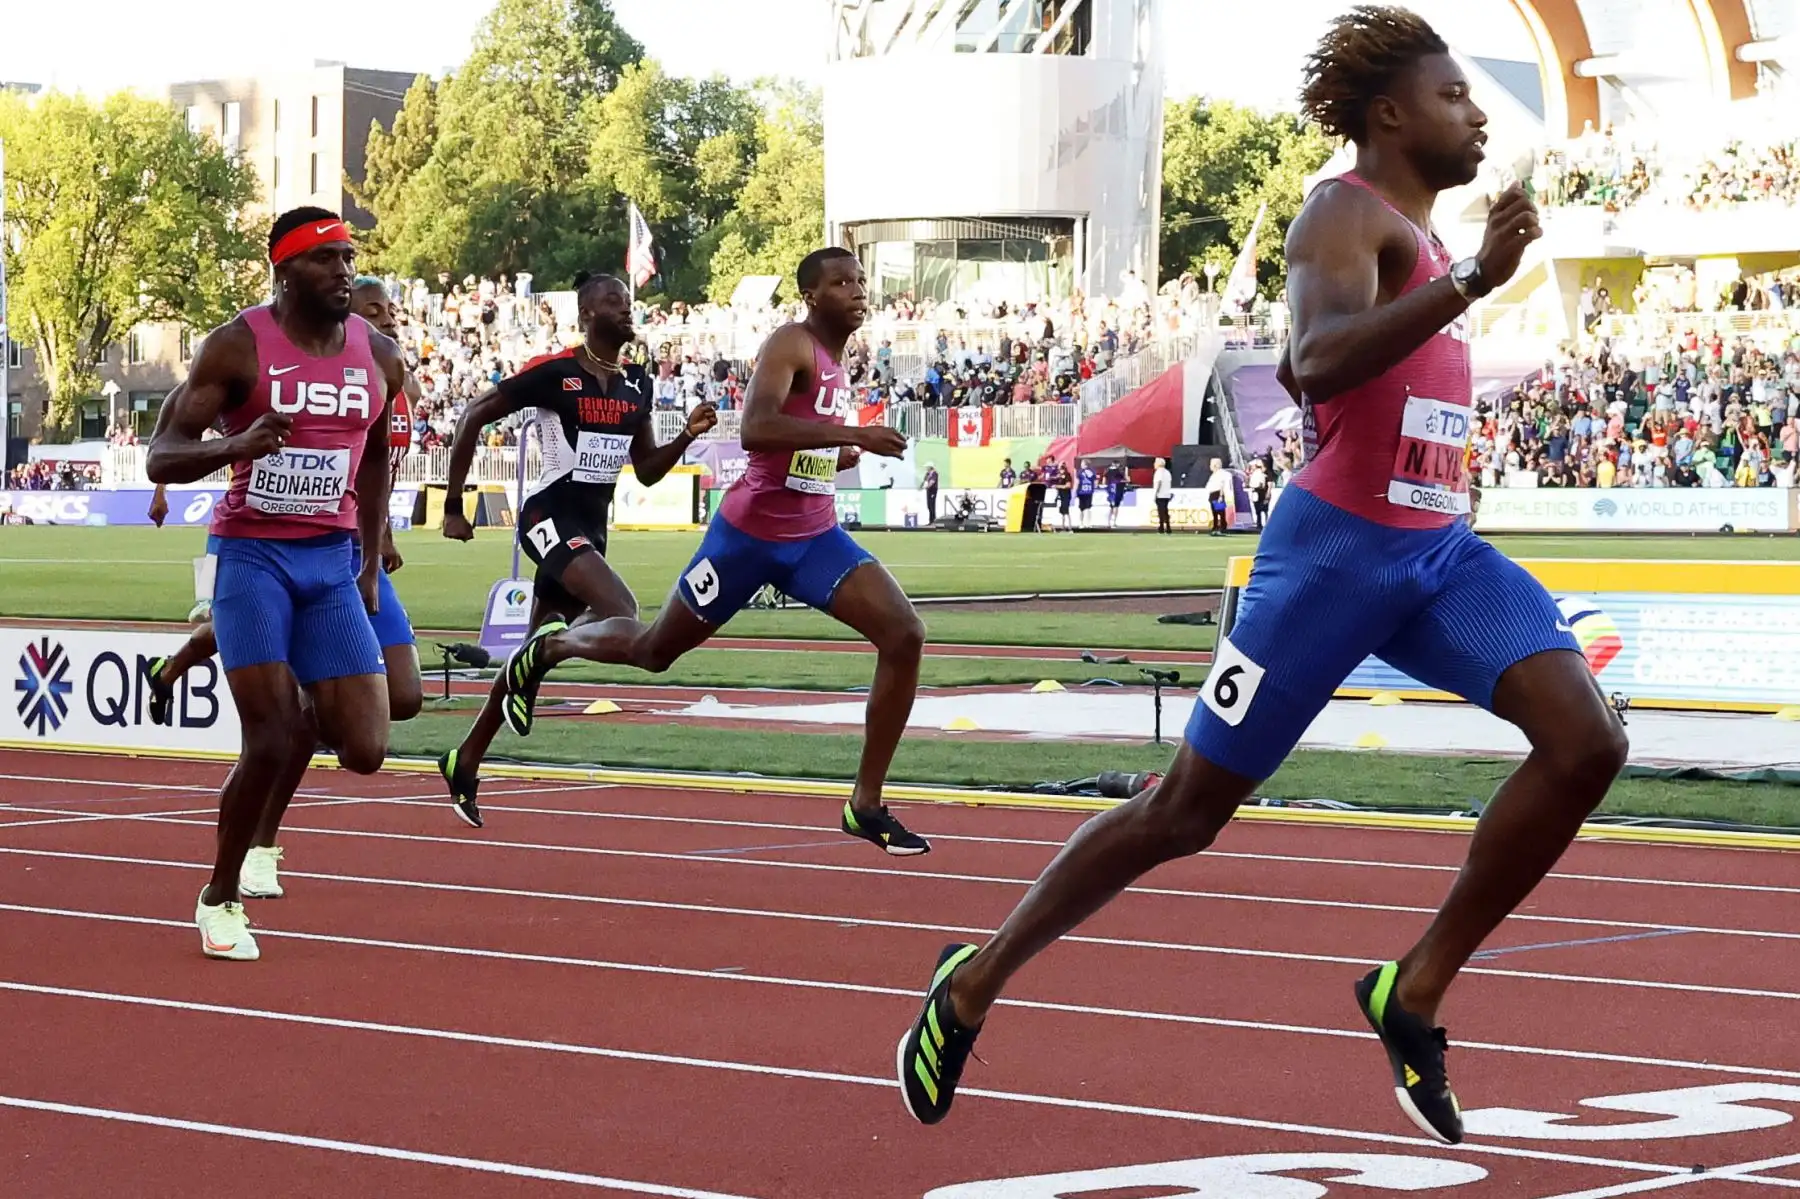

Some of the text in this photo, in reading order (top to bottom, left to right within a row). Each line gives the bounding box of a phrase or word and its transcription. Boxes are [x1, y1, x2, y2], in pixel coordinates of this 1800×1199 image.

[270, 381, 370, 419] USA
[814, 386, 852, 419] US
[600, 436, 629, 451] TDK
[285, 453, 338, 471] TDK
[1403, 441, 1428, 477] N.
[254, 469, 344, 497] BEDNAREK
[1625, 501, 1779, 517] WORLD ATHLETICS
[537, 527, 552, 549] 2
[695, 572, 714, 595] 3
[86, 651, 219, 728] QNB
[1214, 665, 1246, 708] 6
